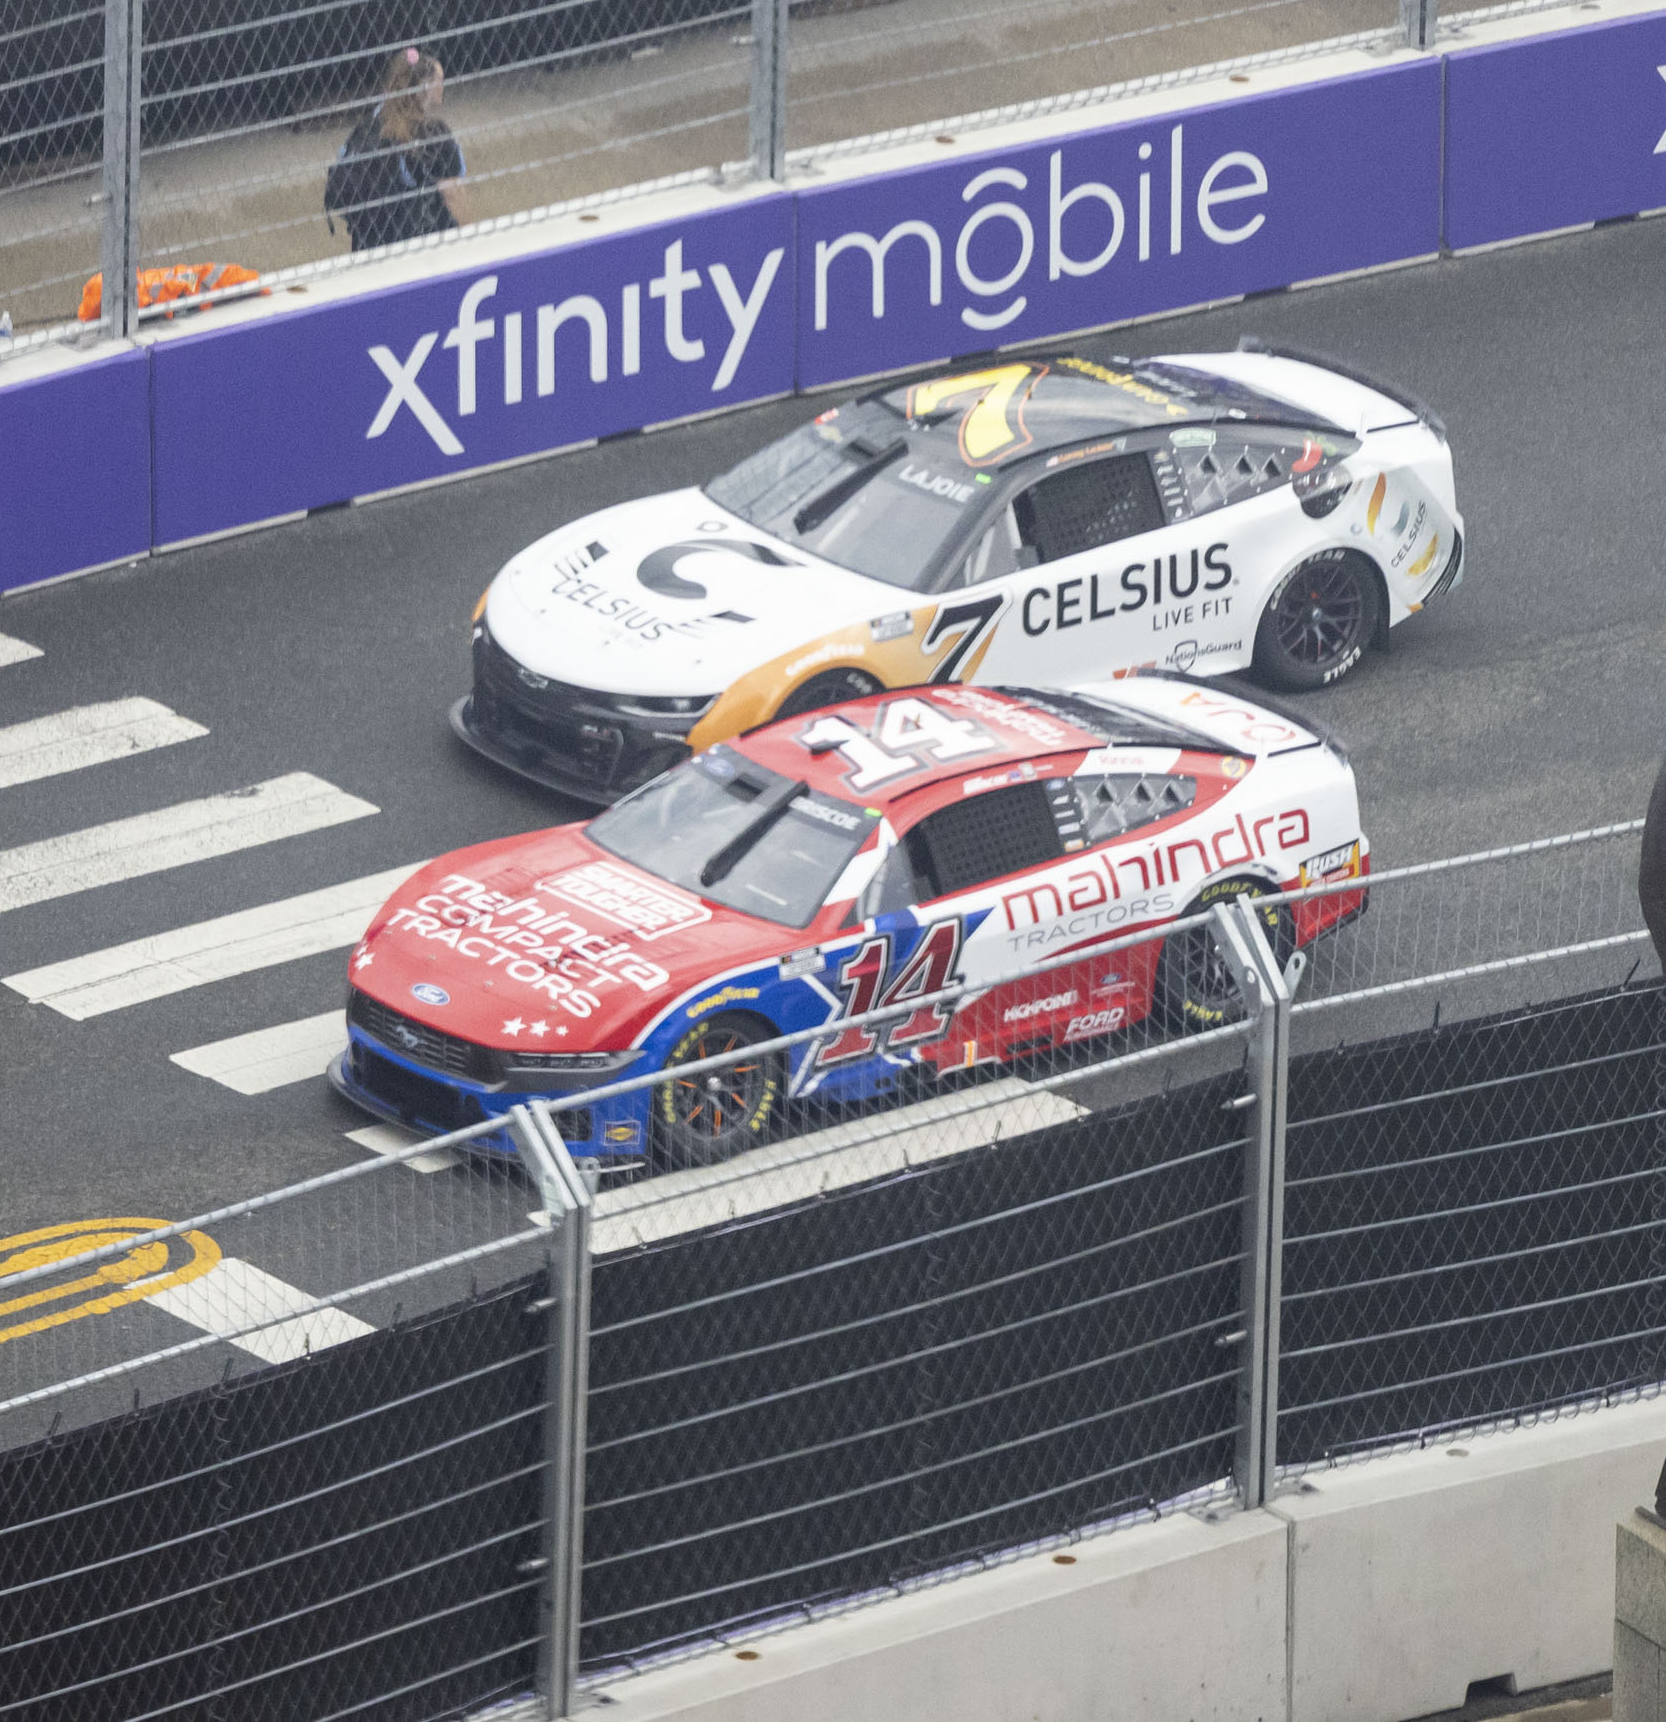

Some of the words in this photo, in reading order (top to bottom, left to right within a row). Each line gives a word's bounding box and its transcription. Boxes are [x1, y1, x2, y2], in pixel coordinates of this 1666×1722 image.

[366, 238, 785, 456] xfinity
[913, 363, 1034, 460] 7
[899, 464, 975, 504] LAJOIE
[1390, 499, 1428, 568] CELSIUS
[551, 578, 671, 643] CELSIUS
[1023, 543, 1232, 637] CELSIUS
[1152, 606, 1193, 631] LIVE
[1202, 597, 1232, 619] FIT
[924, 591, 1006, 684] 7
[1323, 646, 1361, 683] EAGLE
[799, 697, 993, 792] 14
[1002, 808, 1310, 931] mahindra
[388, 908, 602, 1018] TRACTORS
[416, 894, 623, 987] COMPACT
[438, 874, 670, 992] mahindra
[1008, 893, 1174, 952] TRACTORS
[815, 919, 964, 1067] 14
[1067, 1007, 1125, 1035] FORD
